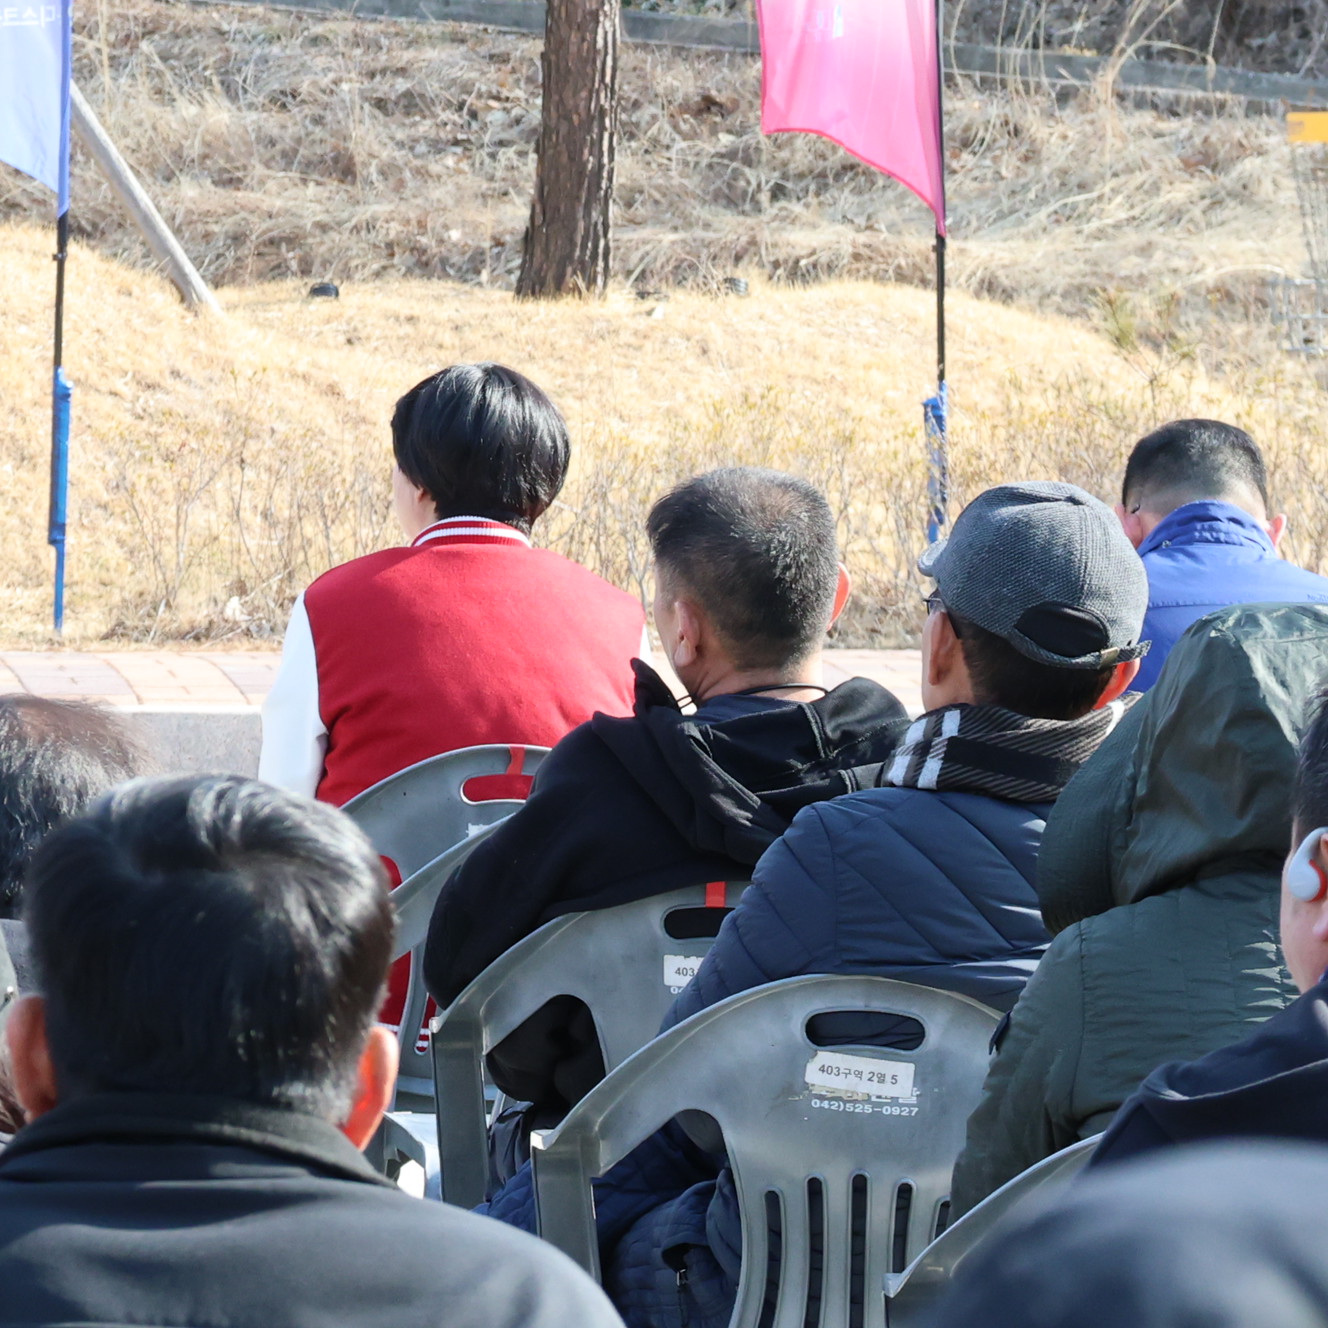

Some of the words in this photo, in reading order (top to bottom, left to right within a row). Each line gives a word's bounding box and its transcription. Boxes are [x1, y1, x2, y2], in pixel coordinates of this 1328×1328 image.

[818, 1063, 864, 1081] 403구역
[866, 1070, 887, 1085] 2열
[890, 1074, 899, 1085] 5
[810, 1098, 920, 1117] 042)525-0927
